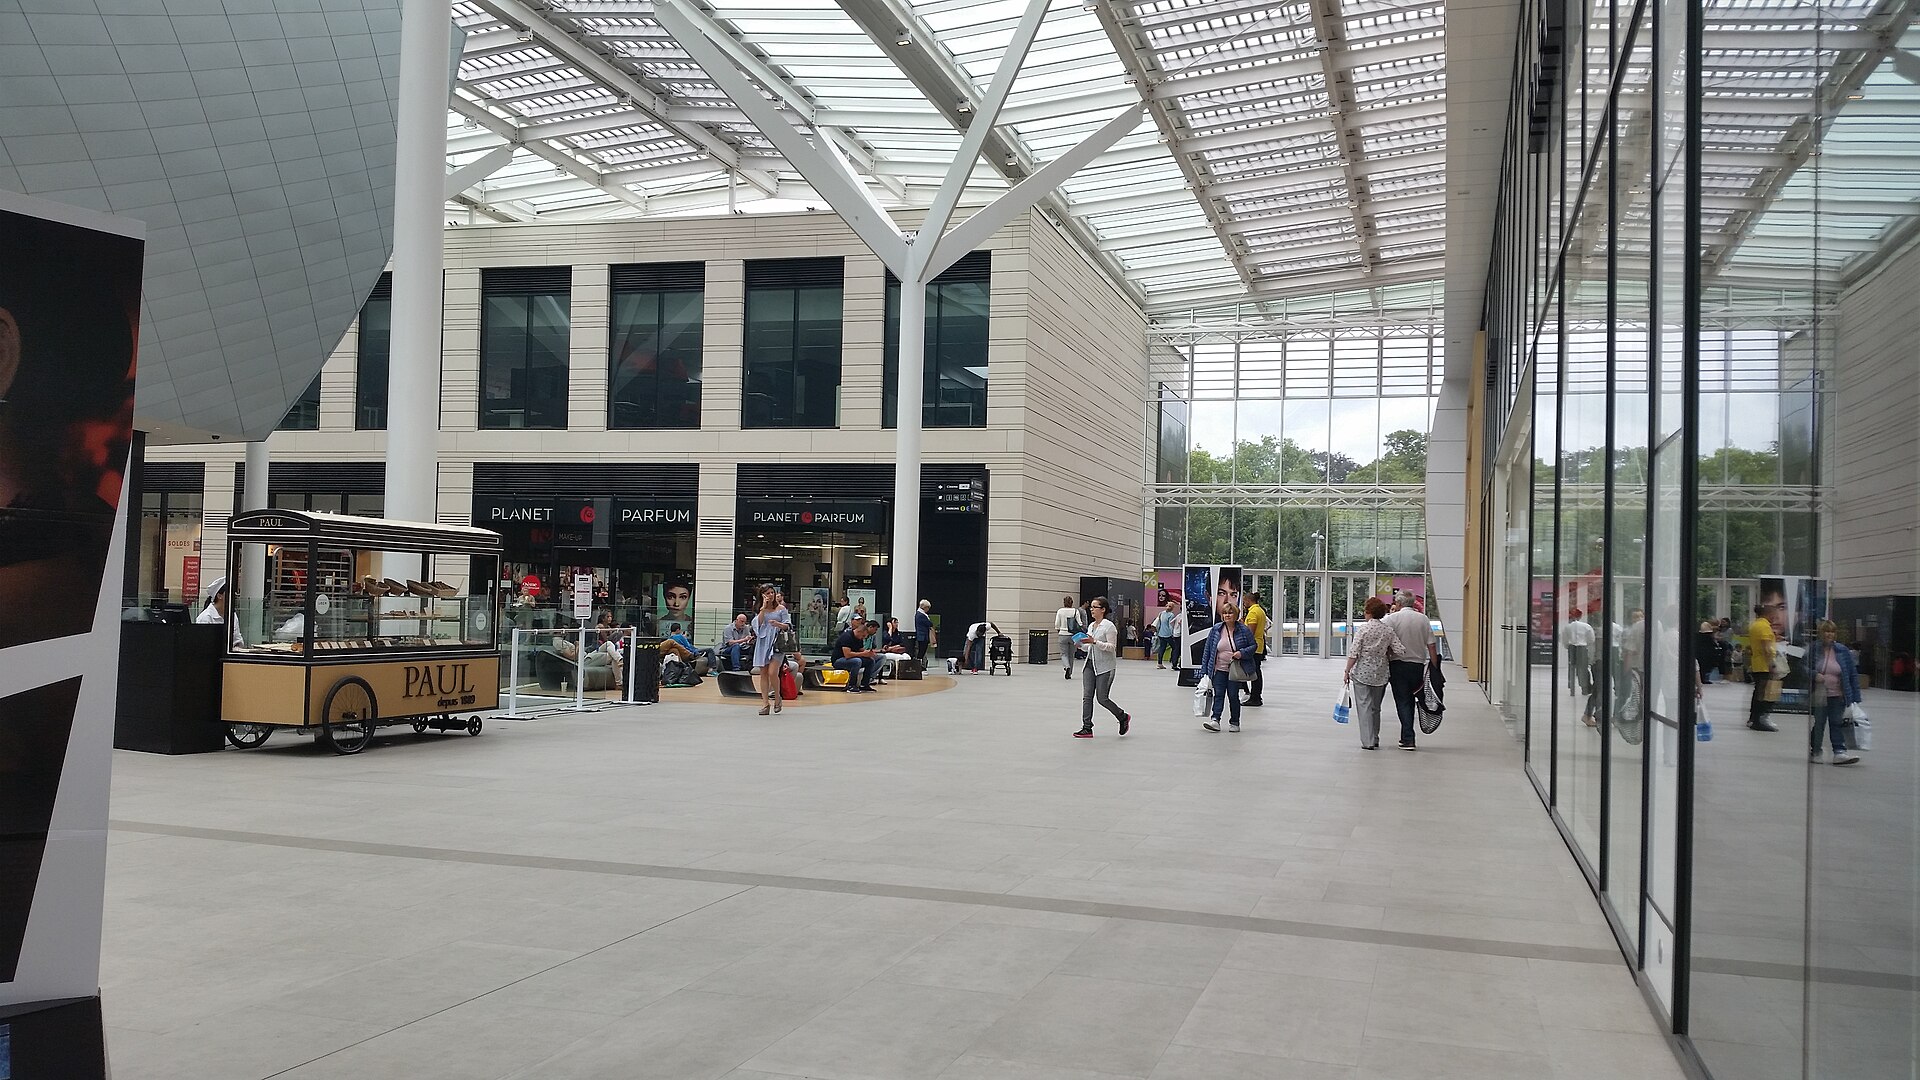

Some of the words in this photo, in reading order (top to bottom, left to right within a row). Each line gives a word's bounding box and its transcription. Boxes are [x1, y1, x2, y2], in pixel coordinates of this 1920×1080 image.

[491, 507, 554, 521] PLANET
[622, 508, 690, 523] PARFUM
[753, 512, 800, 523] PLANET
[814, 512, 865, 524] PARFUM
[259, 518, 284, 527] PAUL
[402, 663, 475, 699] PAUL
[437, 696, 459, 709] depuis
